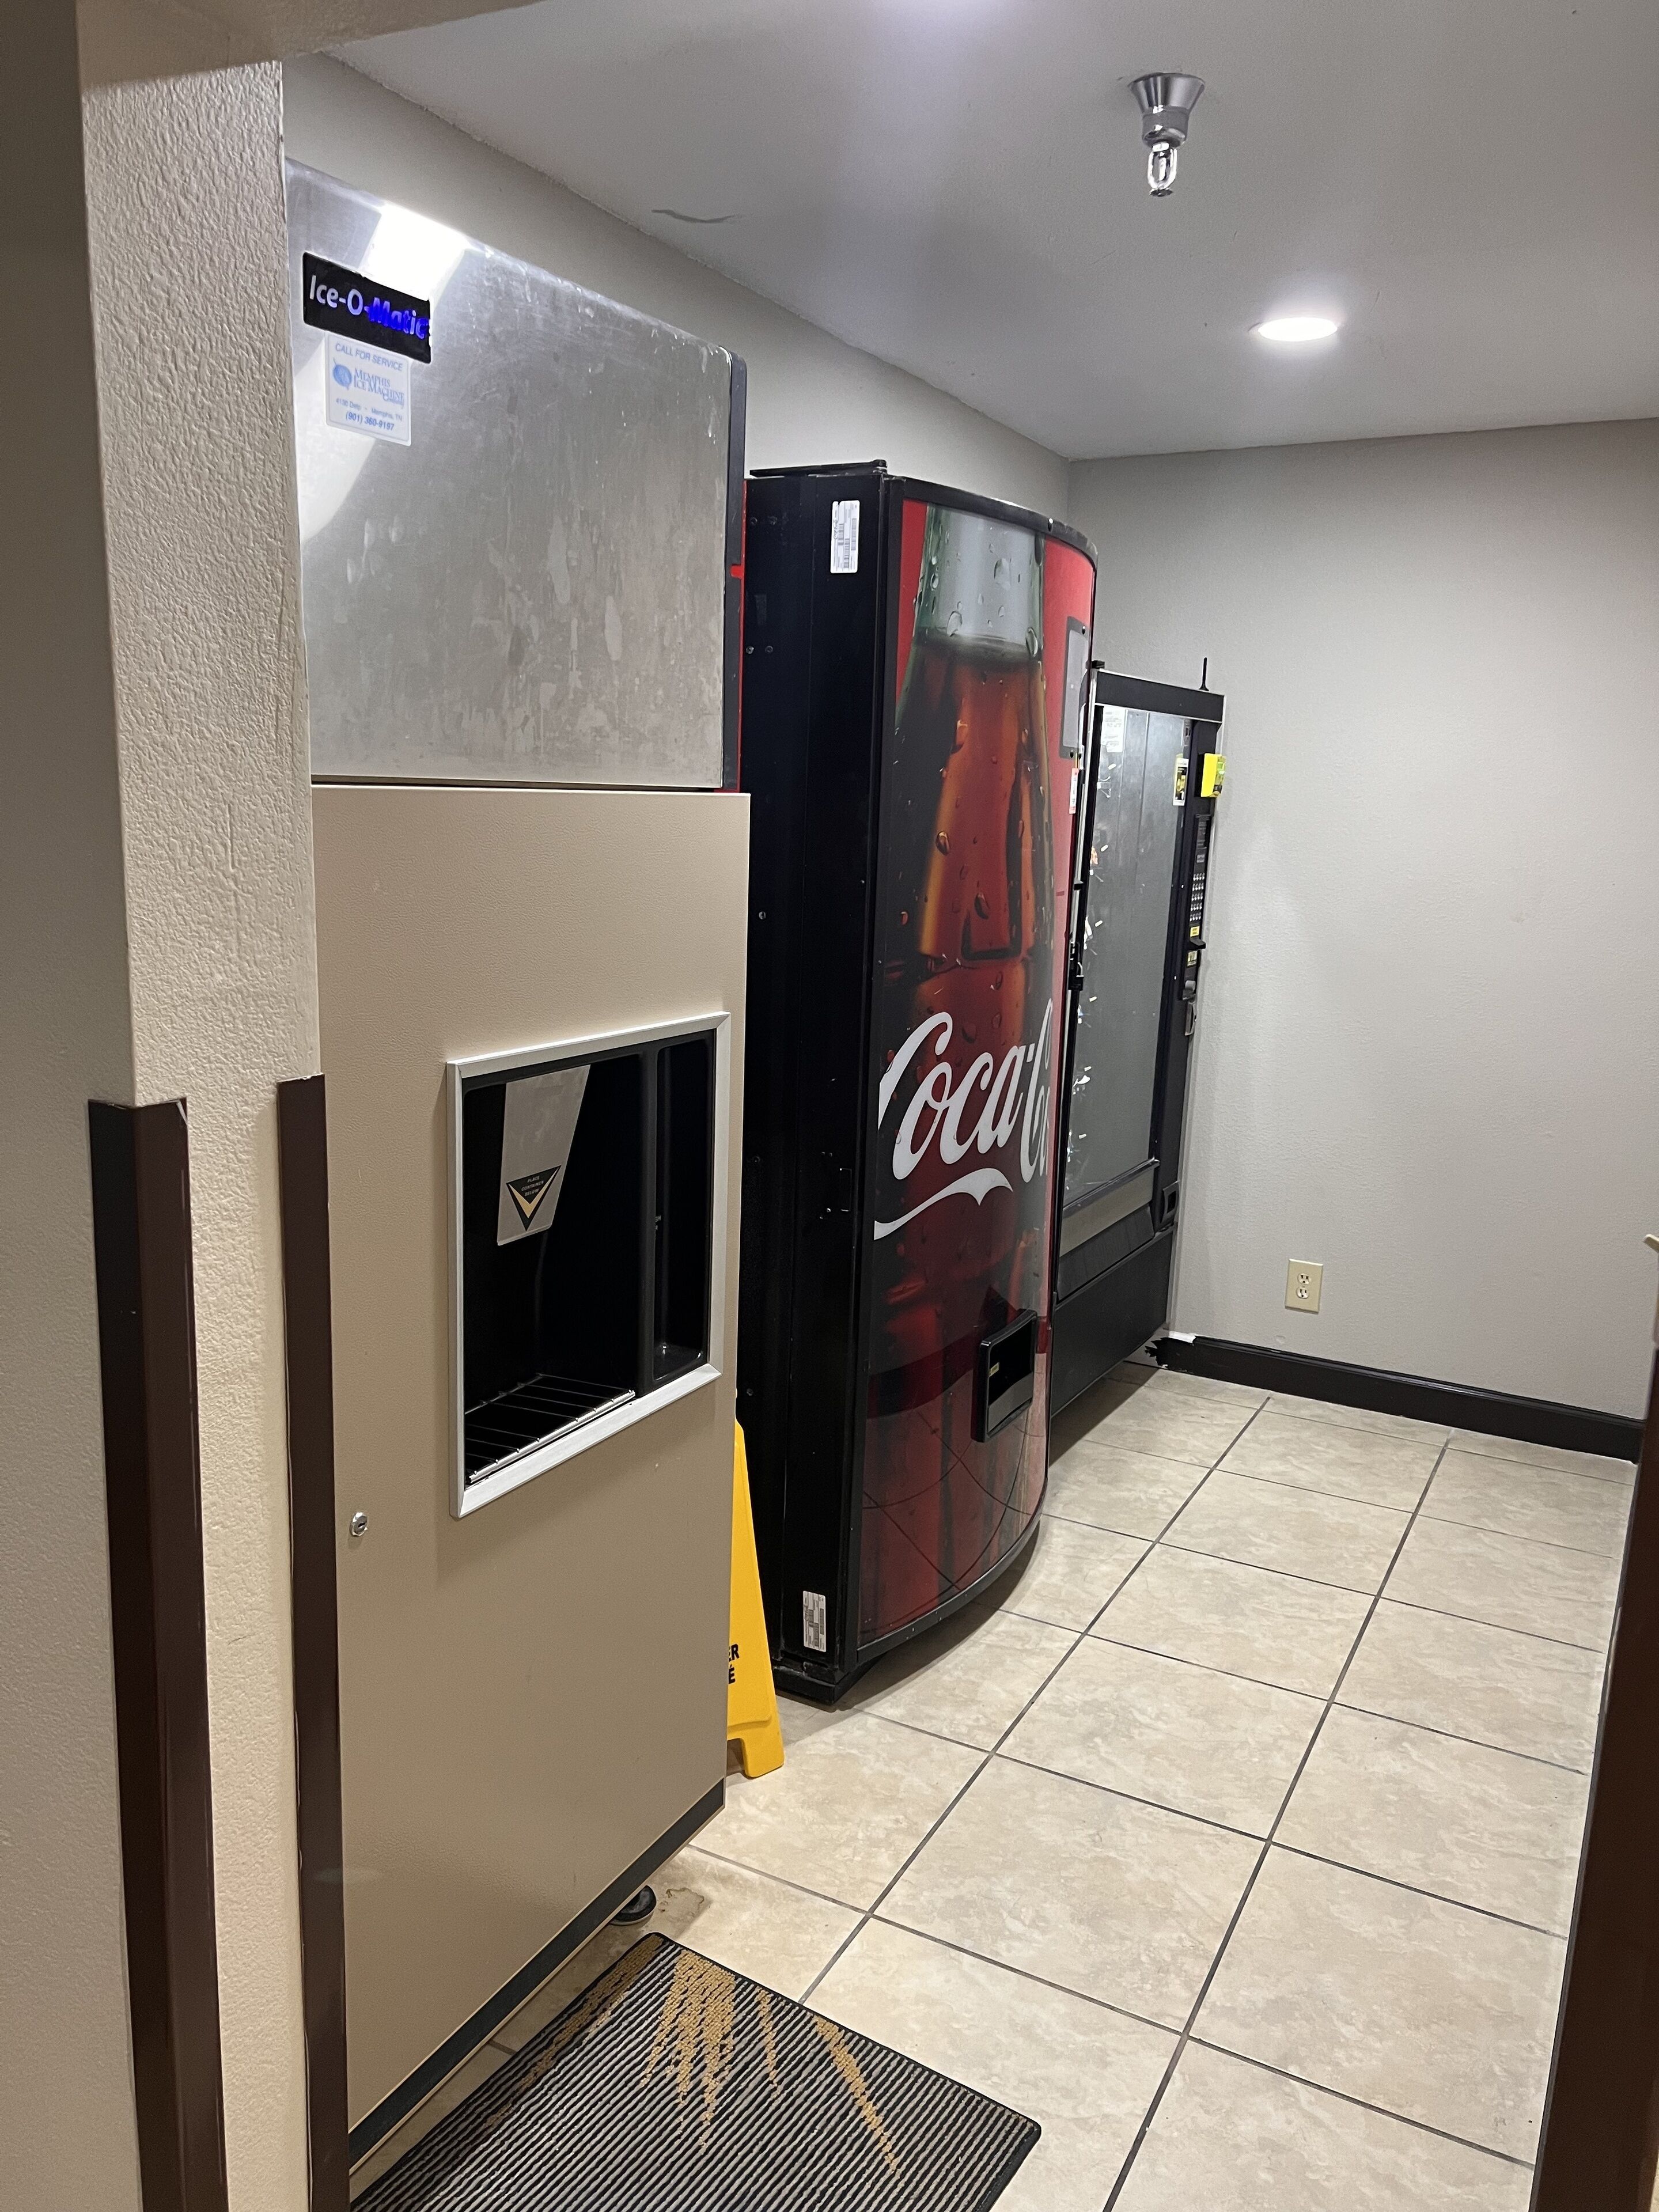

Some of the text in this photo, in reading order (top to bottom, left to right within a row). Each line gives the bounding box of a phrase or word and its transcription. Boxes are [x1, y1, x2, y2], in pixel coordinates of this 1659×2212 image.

[309, 275, 429, 339] Ice-O-Matic
[335, 343, 403, 372] CALL FOR SERVICE
[354, 368, 391, 387] MEMPHIS
[354, 374, 404, 402] ICE MACHINE
[346, 411, 395, 431] (901) 360-9197
